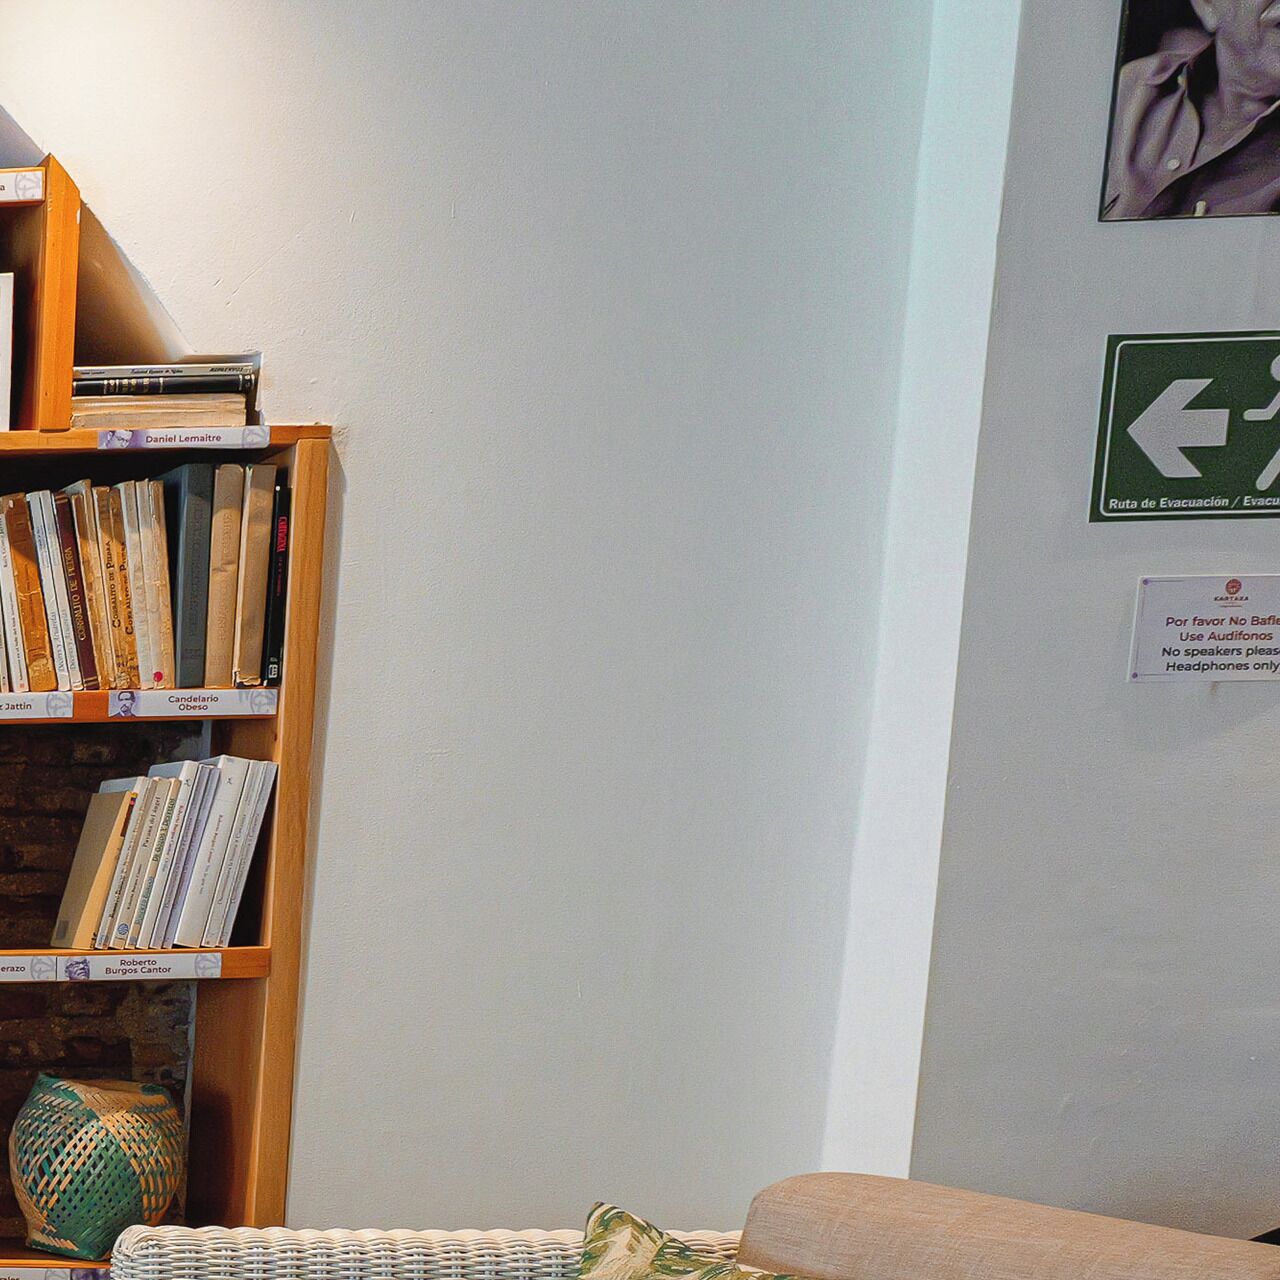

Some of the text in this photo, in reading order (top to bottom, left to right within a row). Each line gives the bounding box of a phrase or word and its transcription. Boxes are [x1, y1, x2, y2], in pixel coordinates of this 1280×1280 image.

[145, 434, 222, 444] Daniel Lemaitre
[1109, 499, 1138, 509] Ruta
[1141, 498, 1156, 508] de
[1159, 496, 1229, 508] Evacuación
[1166, 617, 1188, 627] Por
[1192, 616, 1225, 627] favor
[1229, 616, 1247, 626] No
[1179, 632, 1204, 642] Use
[1161, 645, 1280, 659] No speakers pleas
[1166, 660, 1280, 673] Headphones only
[168, 694, 218, 704] Candelario
[5, 702, 32, 711] Jattin
[178, 703, 208, 712] Obeso
[120, 958, 157, 967] Roberto
[105, 965, 172, 978] Burgos Cantor
